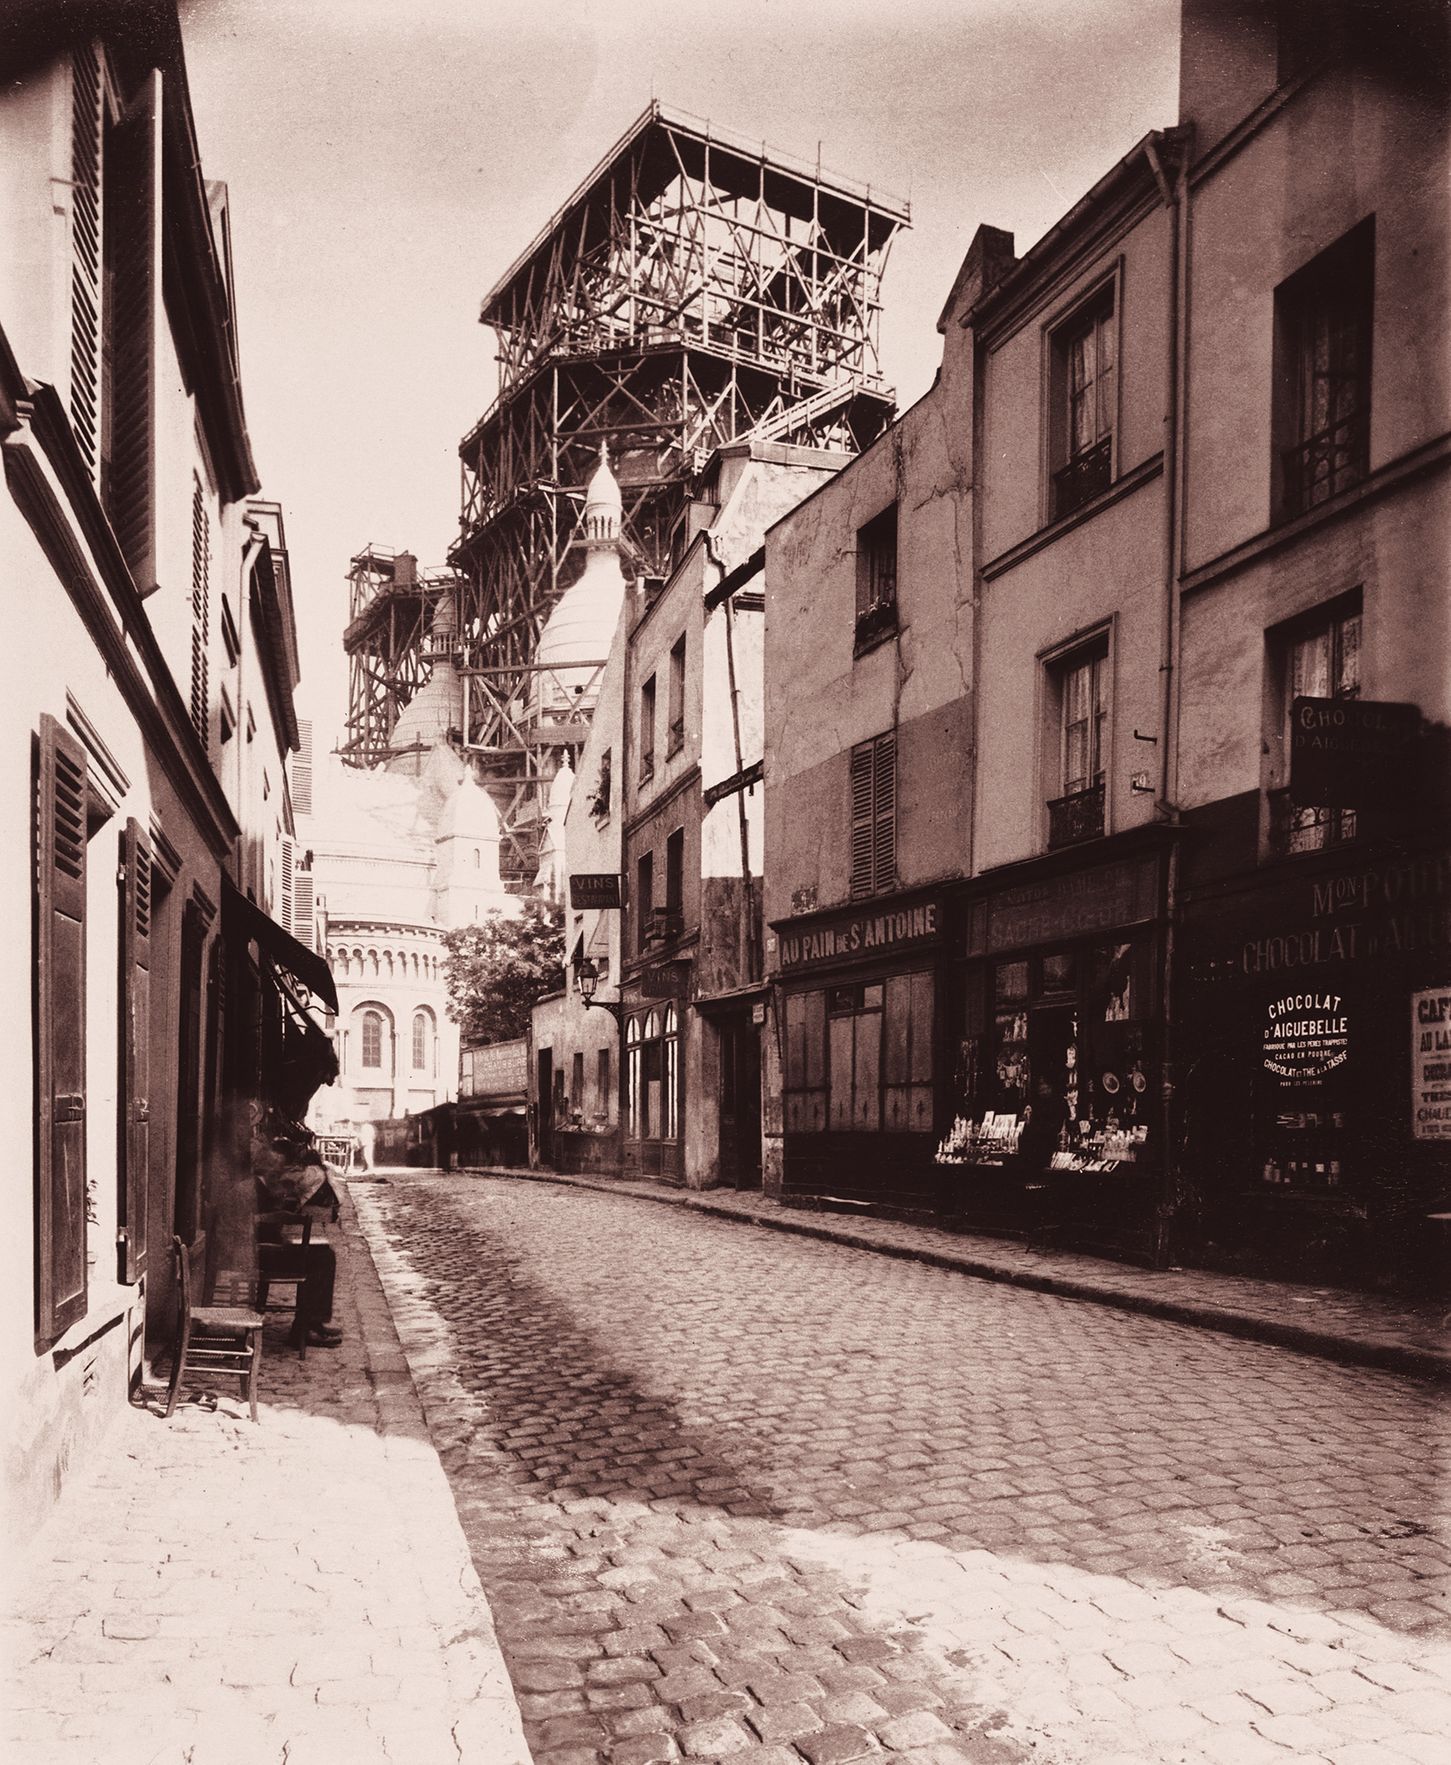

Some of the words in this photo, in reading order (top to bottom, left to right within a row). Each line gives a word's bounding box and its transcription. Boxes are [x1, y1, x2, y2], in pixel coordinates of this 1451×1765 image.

[574, 877, 614, 890] VINS
[782, 937, 800, 965] AU
[802, 929, 835, 961] PAIN
[836, 933, 850, 954] DE
[1243, 922, 1364, 975] CHOCOLAT
[646, 971, 679, 983] VINS
[1268, 993, 1342, 1019] CHOCOLAT
[1417, 997, 1451, 1025] CAF
[1264, 1017, 1348, 1039] D'AIGUEBELLE
[1420, 1031, 1433, 1052] AU
[1264, 1059, 1296, 1077] CHOCOLAT
[1326, 1050, 1348, 1069] TASSE
[1275, 1052, 1295, 1060] CACAO
[1297, 1051, 1305, 1059] EN
